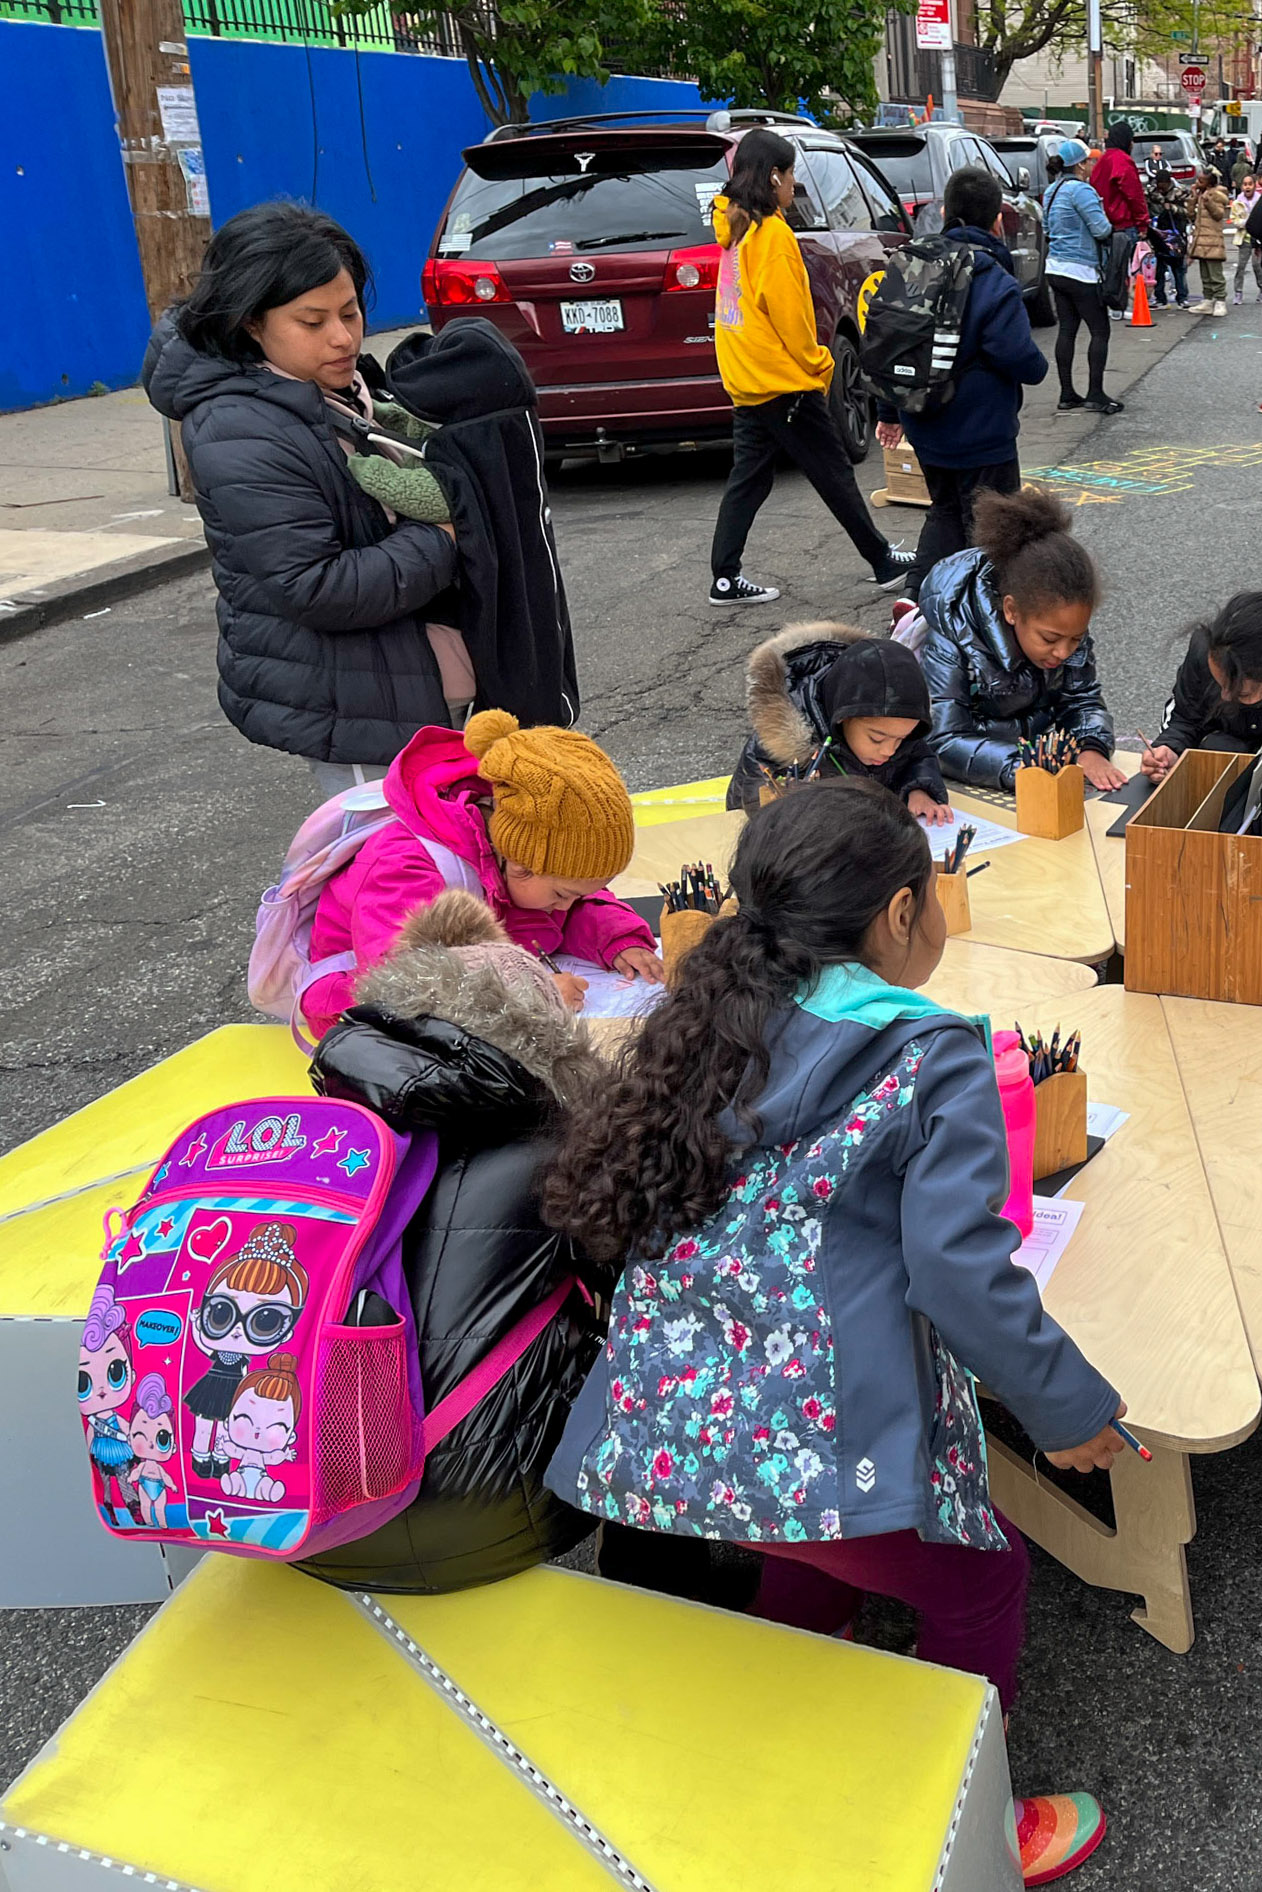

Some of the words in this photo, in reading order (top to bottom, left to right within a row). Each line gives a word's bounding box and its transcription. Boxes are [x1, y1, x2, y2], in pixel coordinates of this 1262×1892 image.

[1183, 75, 1204, 86] STOP
[592, 306, 619, 323] 7088
[219, 1151, 284, 1165] SURPRISE!
[139, 1319, 180, 1336] MAKEOVER!
